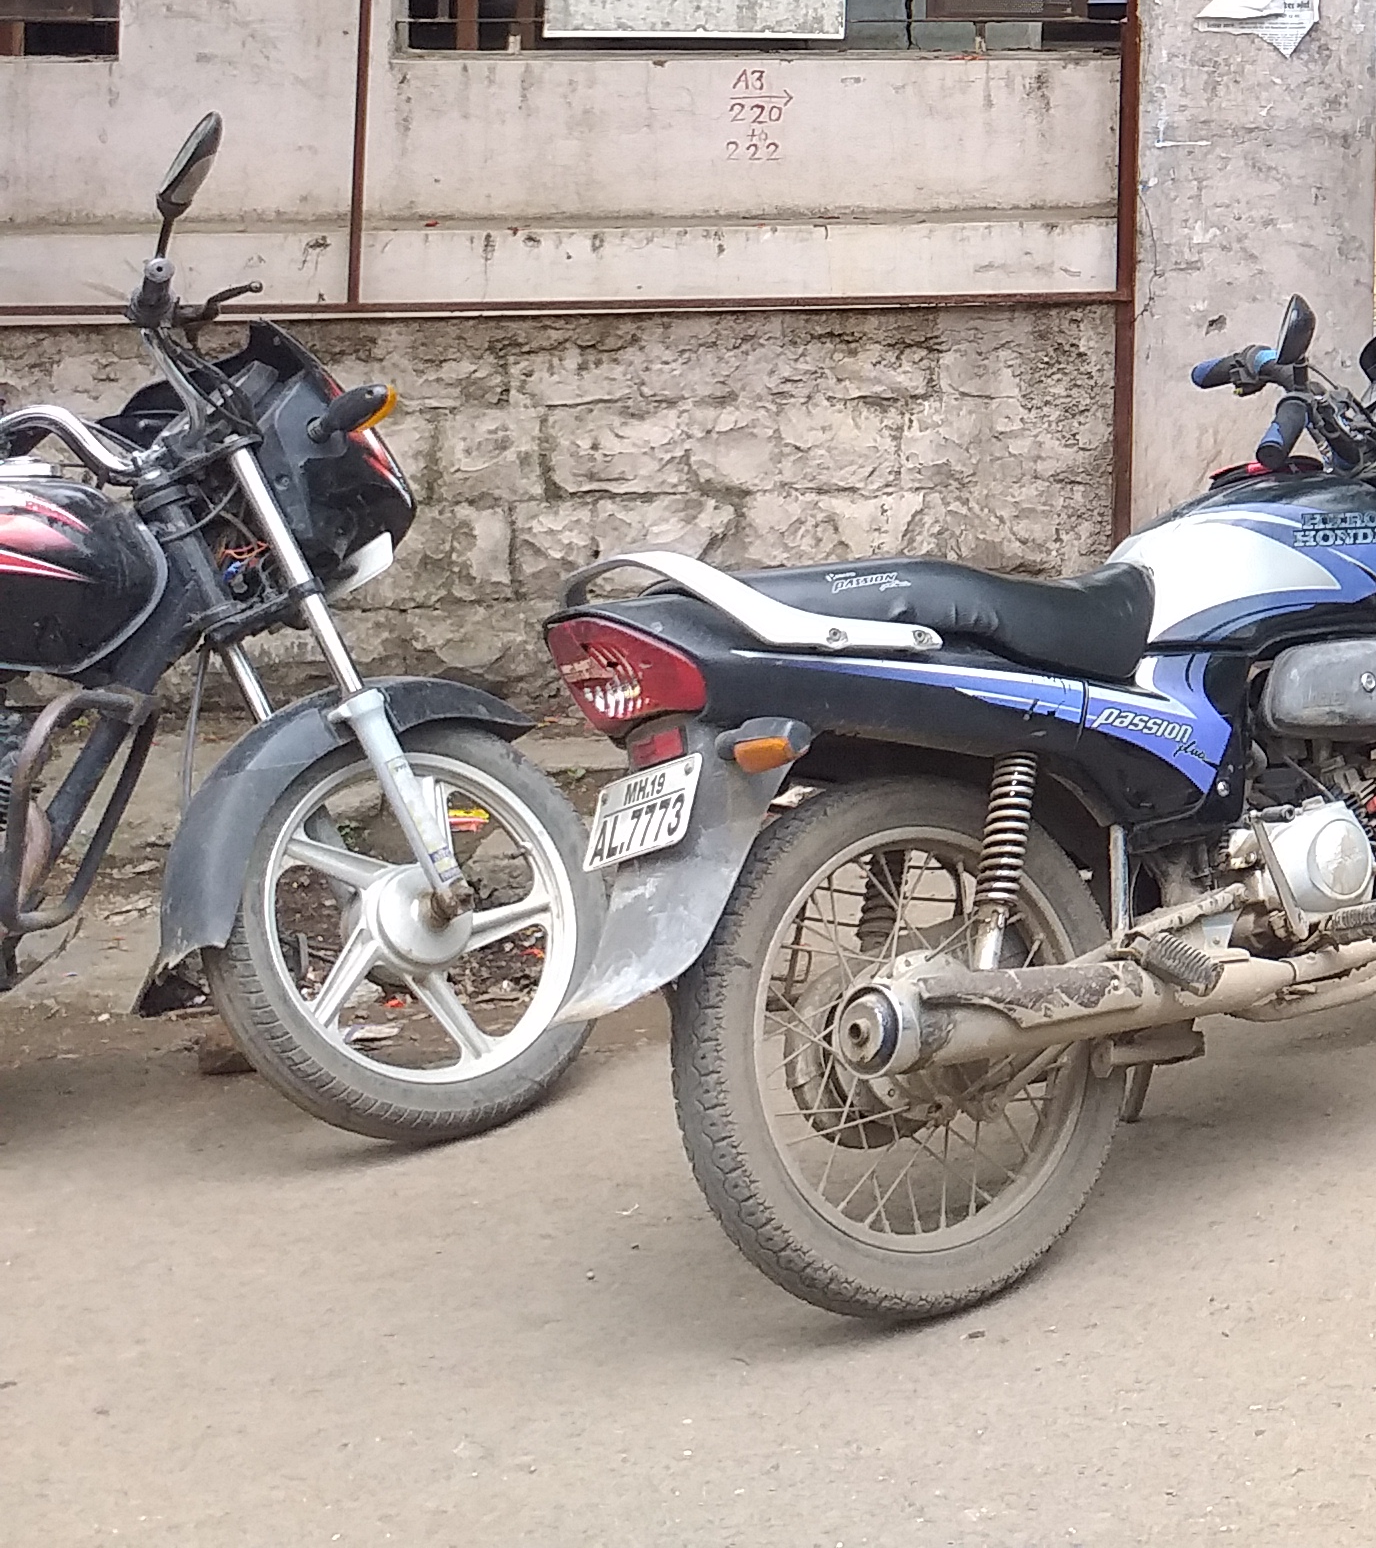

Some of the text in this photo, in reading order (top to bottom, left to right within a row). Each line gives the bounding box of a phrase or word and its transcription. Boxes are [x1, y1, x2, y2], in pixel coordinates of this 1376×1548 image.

[729, 103, 782, 124] 220
[726, 141, 783, 161] 222
[832, 572, 898, 593] PASSION
[1091, 708, 1193, 743] passion
[624, 773, 665, 806] MH.19
[589, 793, 685, 866] AL.7773
